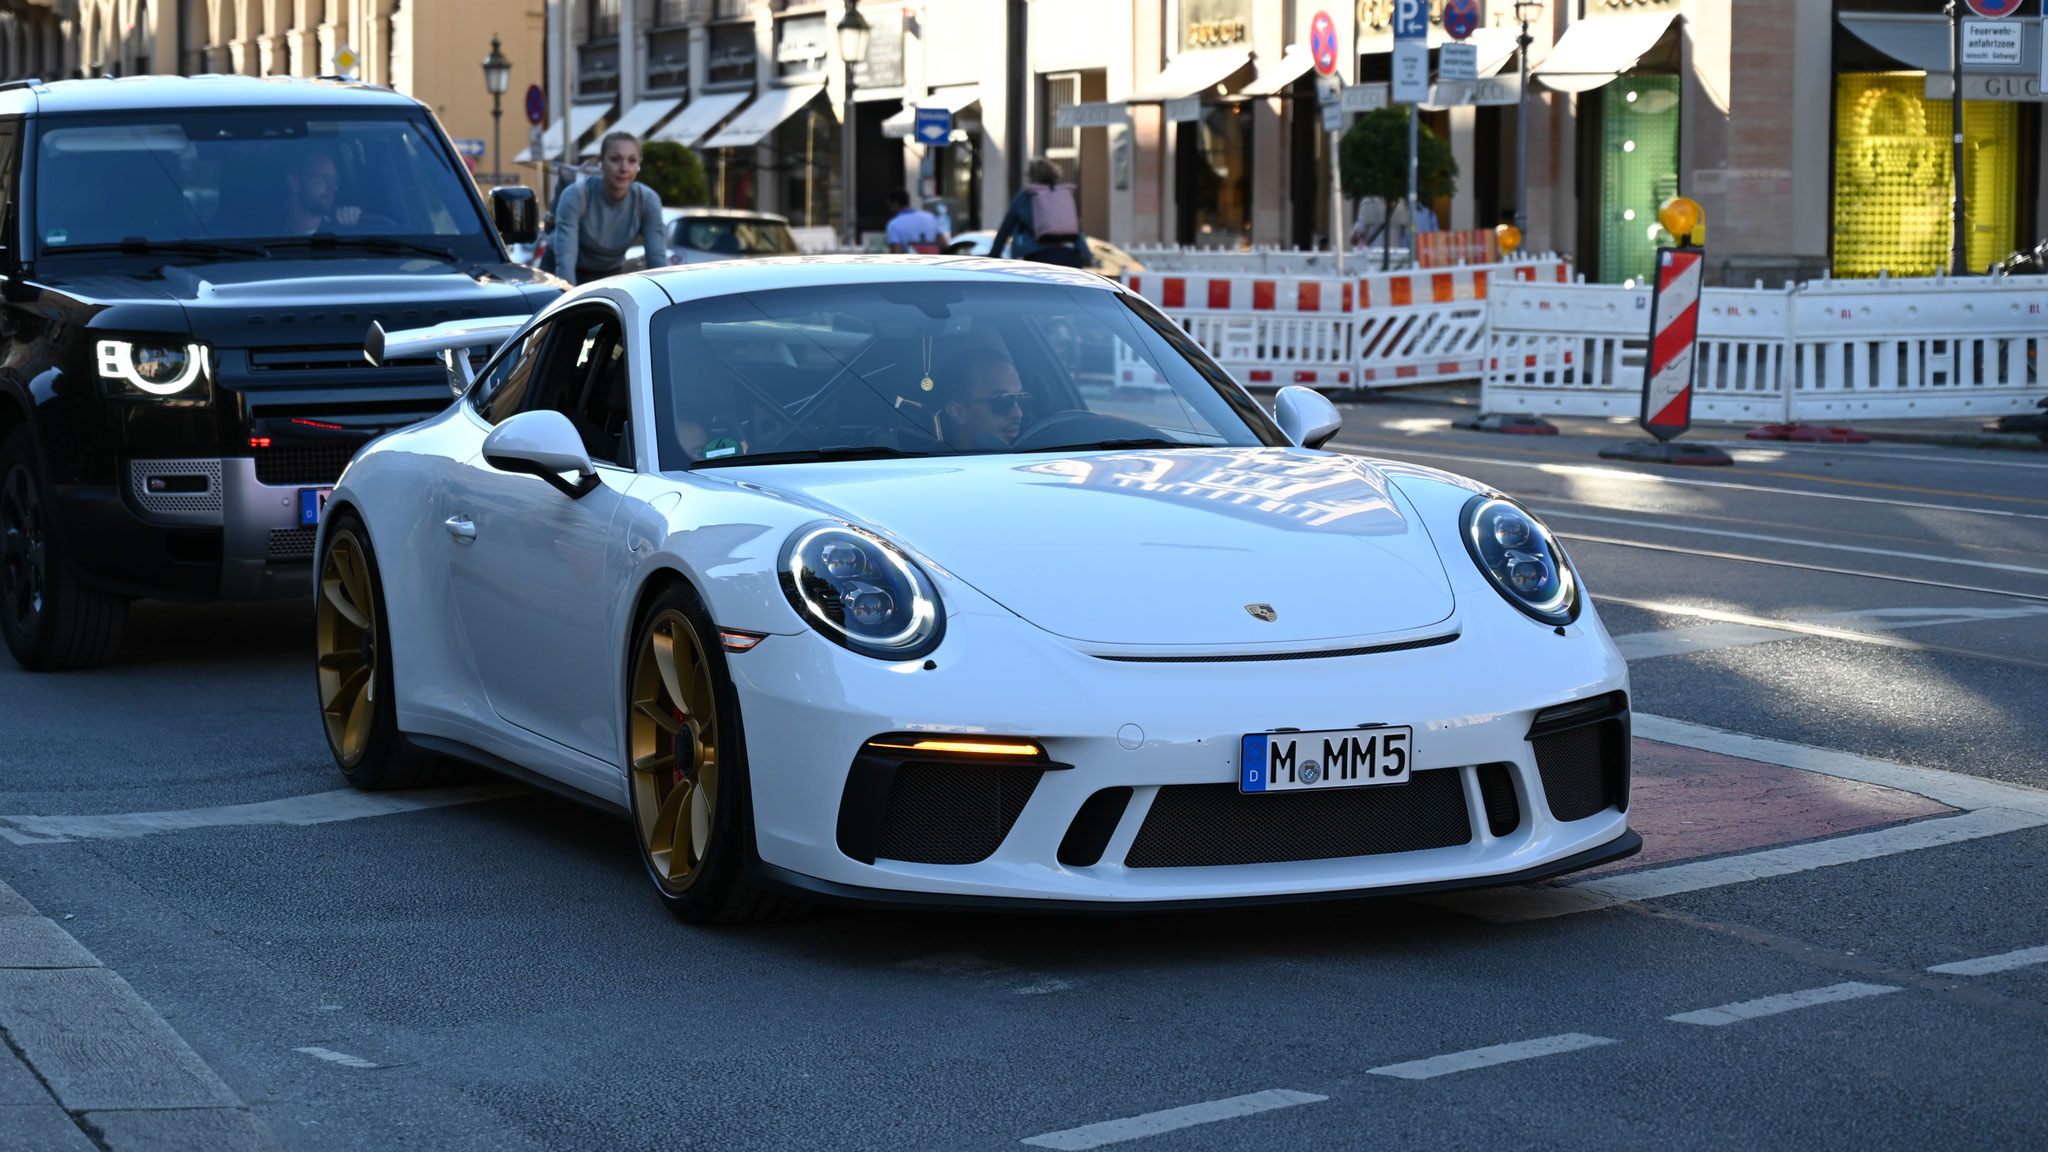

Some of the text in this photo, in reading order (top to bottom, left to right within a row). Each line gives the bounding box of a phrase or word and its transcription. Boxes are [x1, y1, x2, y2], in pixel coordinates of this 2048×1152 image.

[1398, 0, 1419, 34] P
[1970, 26, 2016, 35] Feuerwehr-
[1969, 39, 2015, 48] anfahrtzone
[1270, 740, 1297, 784] M
[1249, 770, 1259, 782] D
